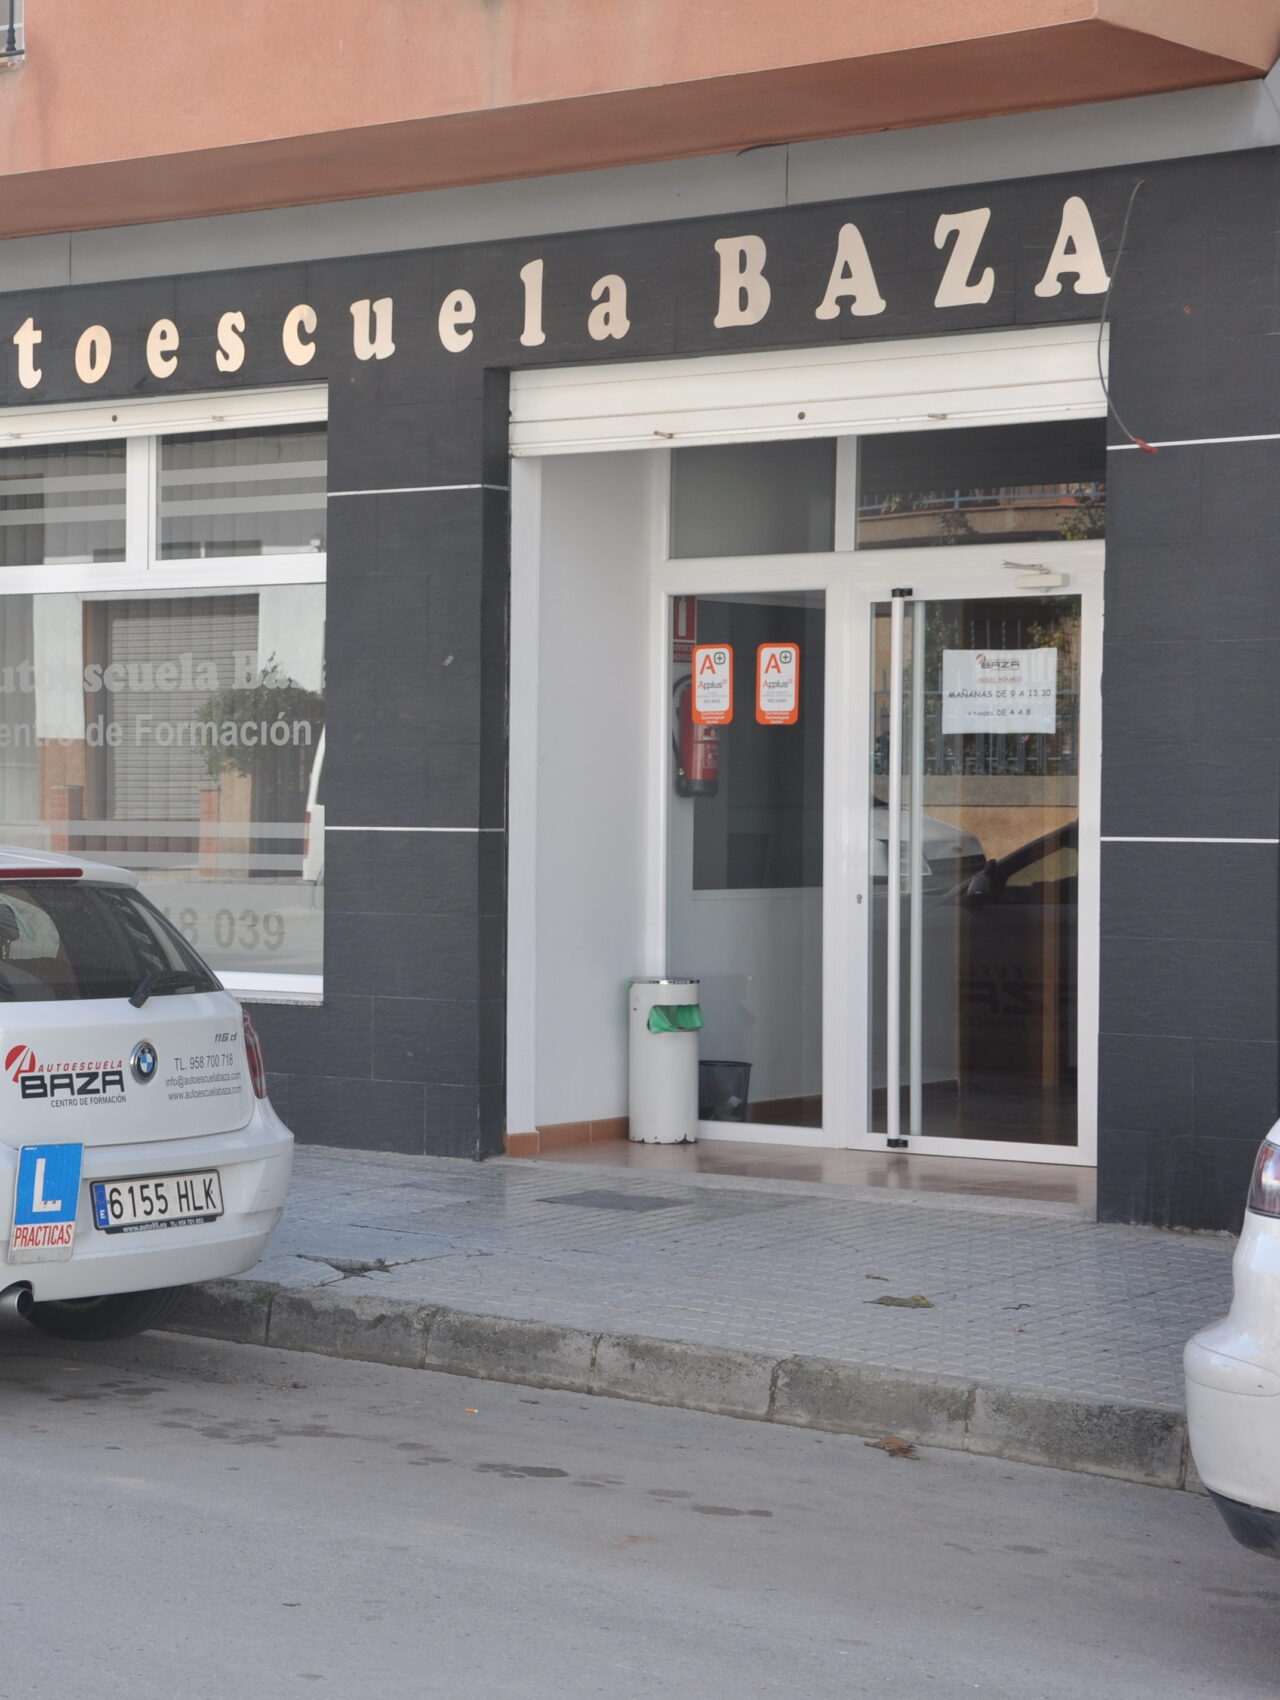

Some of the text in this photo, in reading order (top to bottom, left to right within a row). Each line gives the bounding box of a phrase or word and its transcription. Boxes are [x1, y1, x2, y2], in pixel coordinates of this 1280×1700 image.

[713, 196, 1112, 329] BAZA
[981, 660, 1020, 669] BAZA
[948, 689, 993, 698] MAÑANAS
[996, 689, 1007, 698] DE
[1010, 689, 1015, 698] 9
[1019, 690, 1024, 698] A
[996, 708, 1007, 717] DE
[1010, 708, 1015, 716] 4
[85, 714, 124, 748] de
[134, 711, 313, 748] Formación
[213, 908, 286, 951] 039
[38, 1059, 123, 1073] AUTOESCUELA
[189, 1056, 205, 1070] 958
[206, 1054, 220, 1068] 700
[20, 1070, 125, 1099] BAZA
[50, 1094, 127, 1108] CENTRO DE FORMACIÓN
[32, 1157, 62, 1213] L
[100, 1178, 217, 1219] E 6155 HLK
[13, 1223, 73, 1248] PRACTICAS
